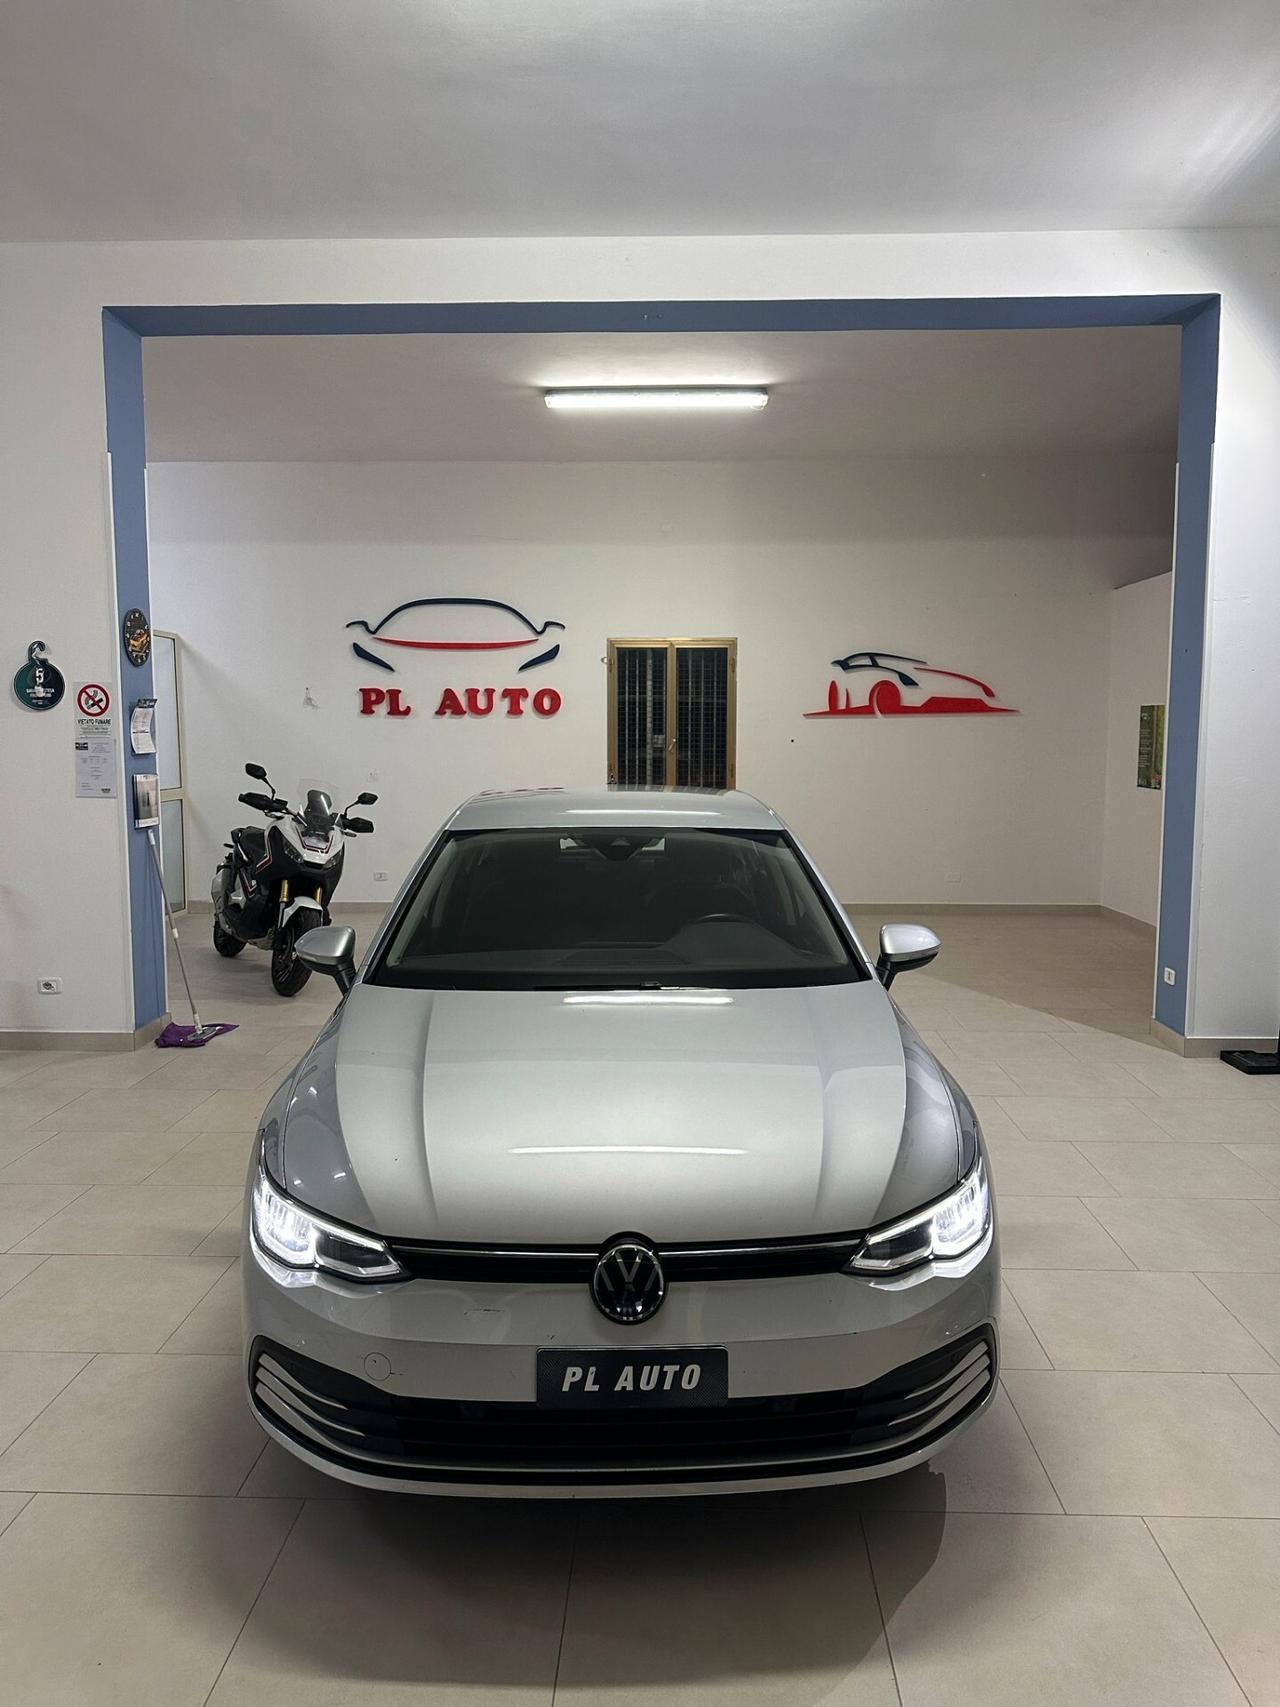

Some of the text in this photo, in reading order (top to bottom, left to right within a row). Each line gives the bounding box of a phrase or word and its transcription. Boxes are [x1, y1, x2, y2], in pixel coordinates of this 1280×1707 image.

[359, 688, 562, 716] PL AUTO
[561, 1364, 702, 1392] PL AUTO
